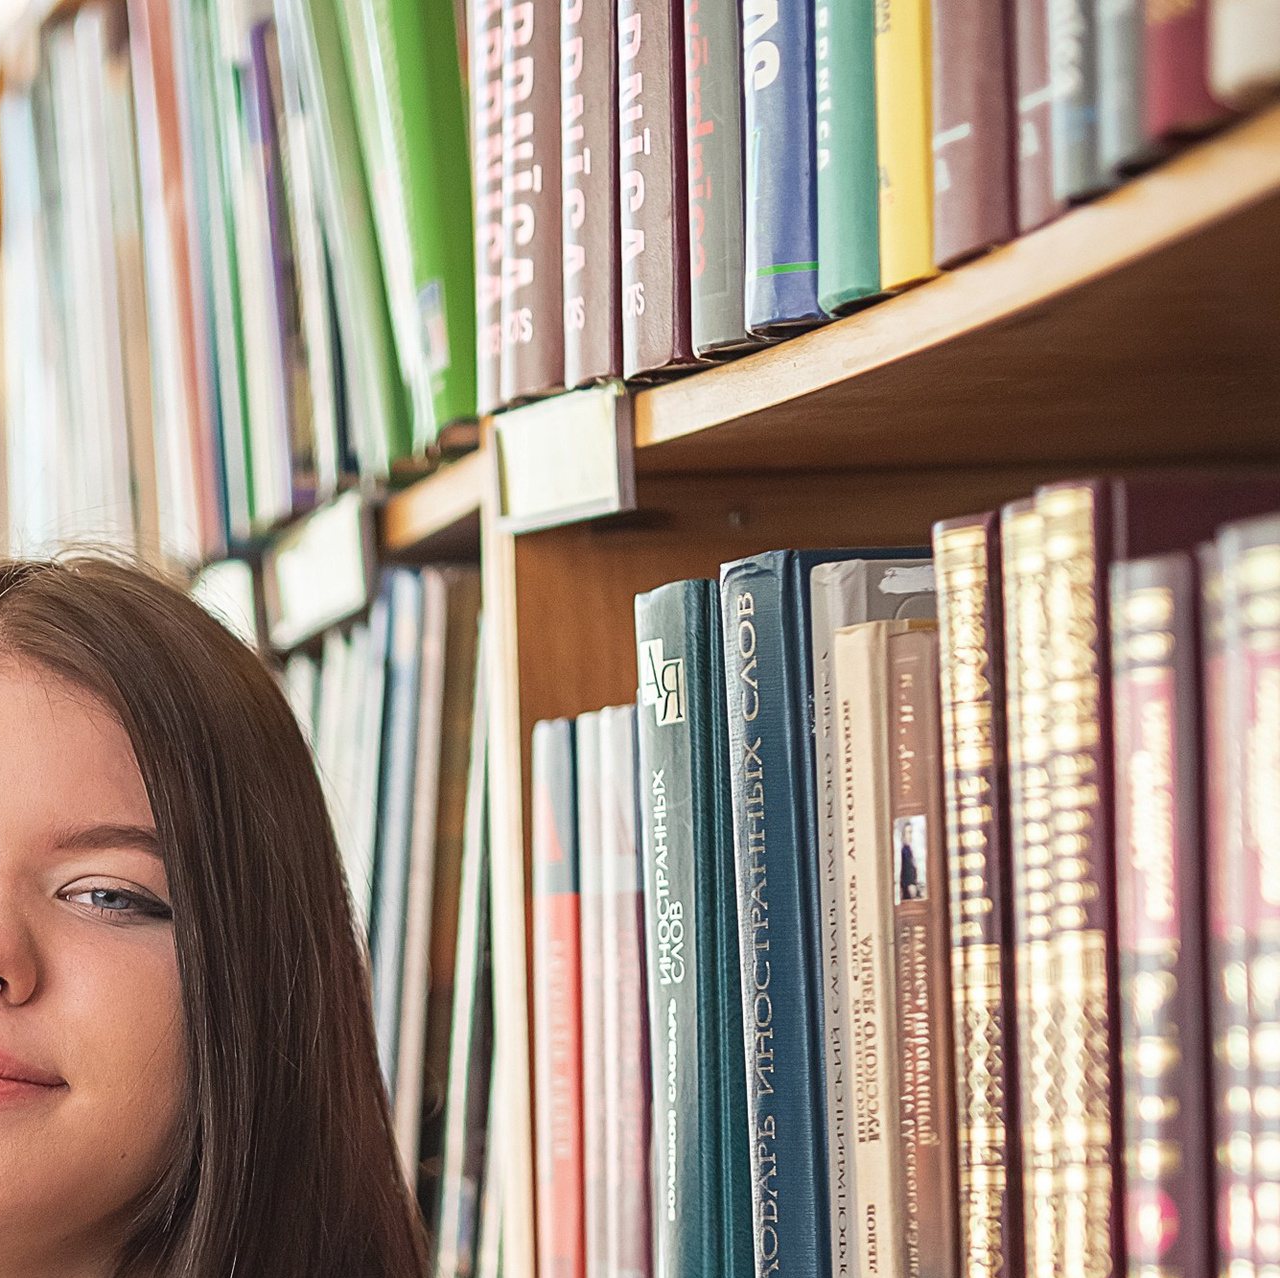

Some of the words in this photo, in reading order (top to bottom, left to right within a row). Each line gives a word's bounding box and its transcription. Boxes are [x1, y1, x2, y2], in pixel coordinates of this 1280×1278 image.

[736, 592, 759, 721] СЛОВ
[824, 753, 836, 882] РУССКОГО
[843, 699, 857, 861] АНТОНИМОВ
[652, 769, 673, 984] ИНОСТРАННЫХ
[743, 737, 775, 1094] ИНОСТРАННЫХ
[847, 874, 860, 982] СЛОВАРЬ
[669, 900, 684, 984] СЛОВ
[827, 898, 841, 1016] СЛОВАРЬ
[859, 933, 882, 1015] ЯЗЫКА
[666, 997, 677, 1102] СЛОВАРЬ
[852, 997, 867, 1143] ШКОЛЬНЫЙ
[862, 1020, 881, 1143] РУССКОГО
[665, 1109, 677, 1221] БОЛЬШОЙ
[865, 1203, 879, 1274] ЛЬВОВ
